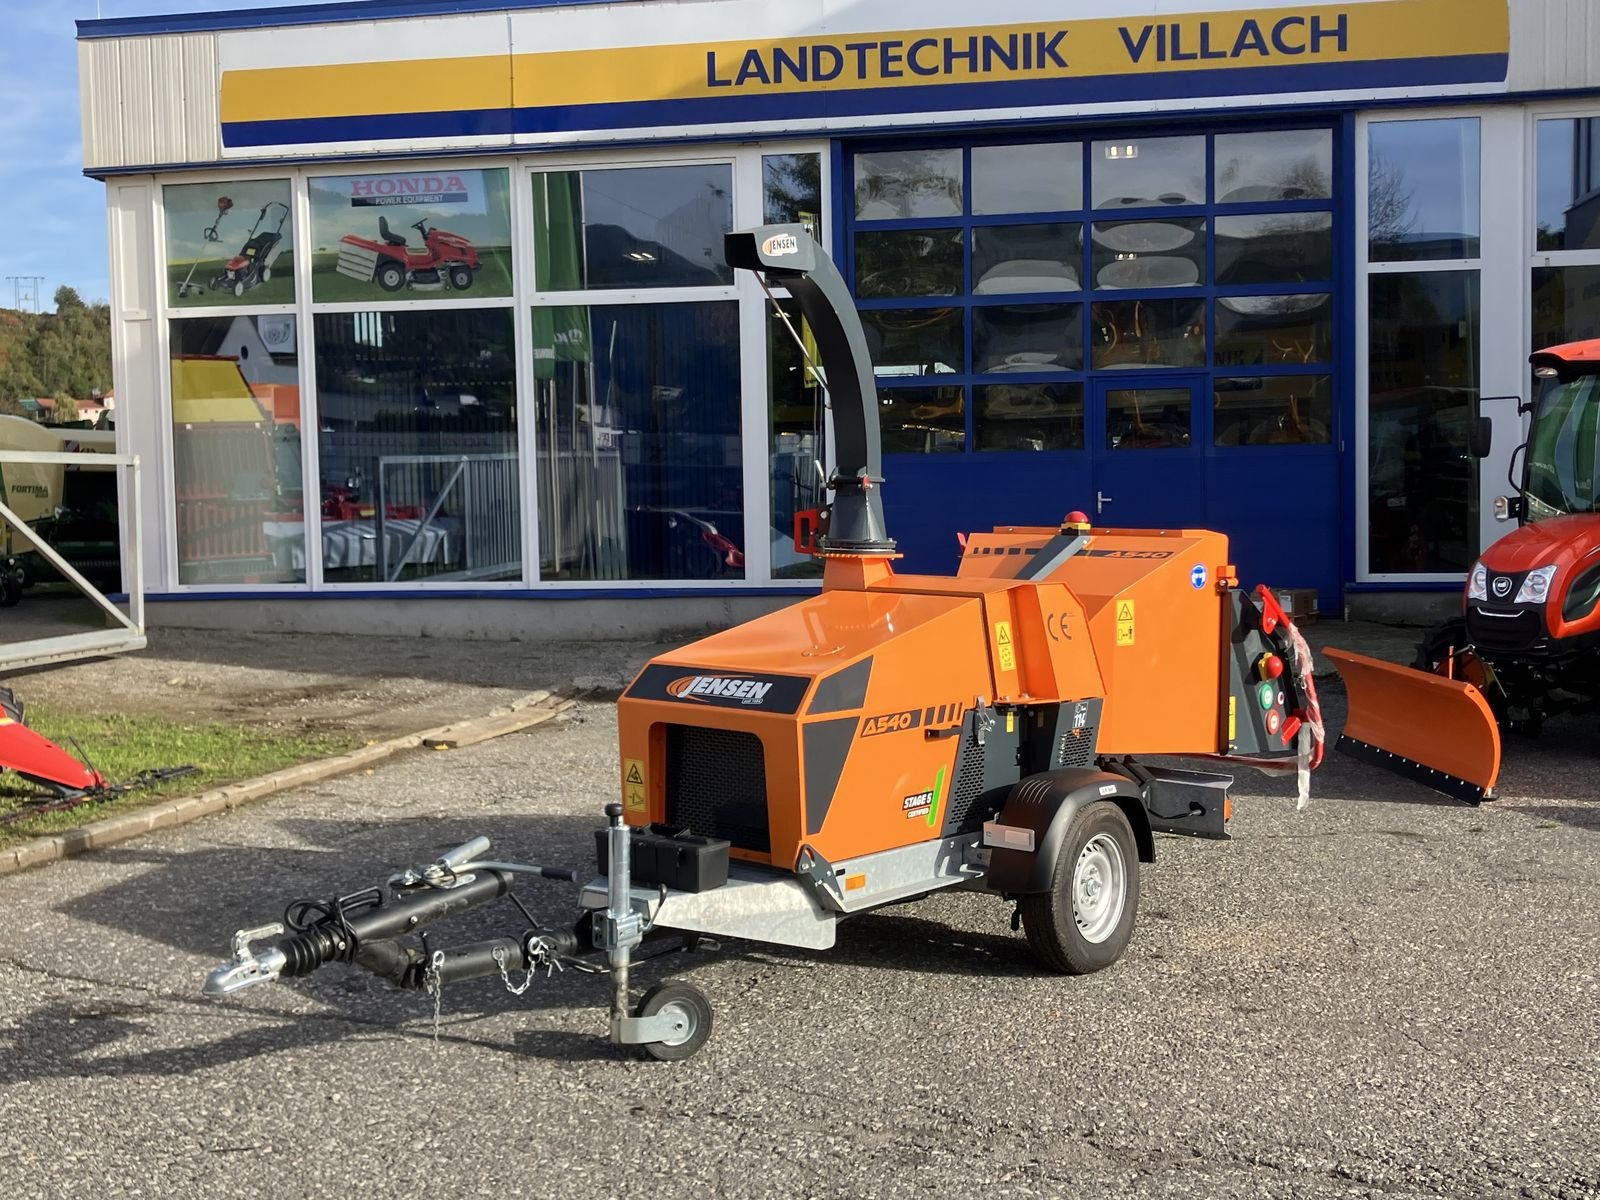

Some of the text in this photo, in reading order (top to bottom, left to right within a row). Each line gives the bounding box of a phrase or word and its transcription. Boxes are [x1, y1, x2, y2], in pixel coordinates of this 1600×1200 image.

[707, 14, 1347, 87] LANDTECHNIK VILLACH
[351, 176, 466, 196] HONDA
[376, 195, 443, 205] POWER EQUIPMENT
[11, 485, 48, 494] FORTIMA
[677, 676, 773, 698] JENSEN
[862, 713, 911, 736] A540
[903, 792, 932, 809] STAGE 5
